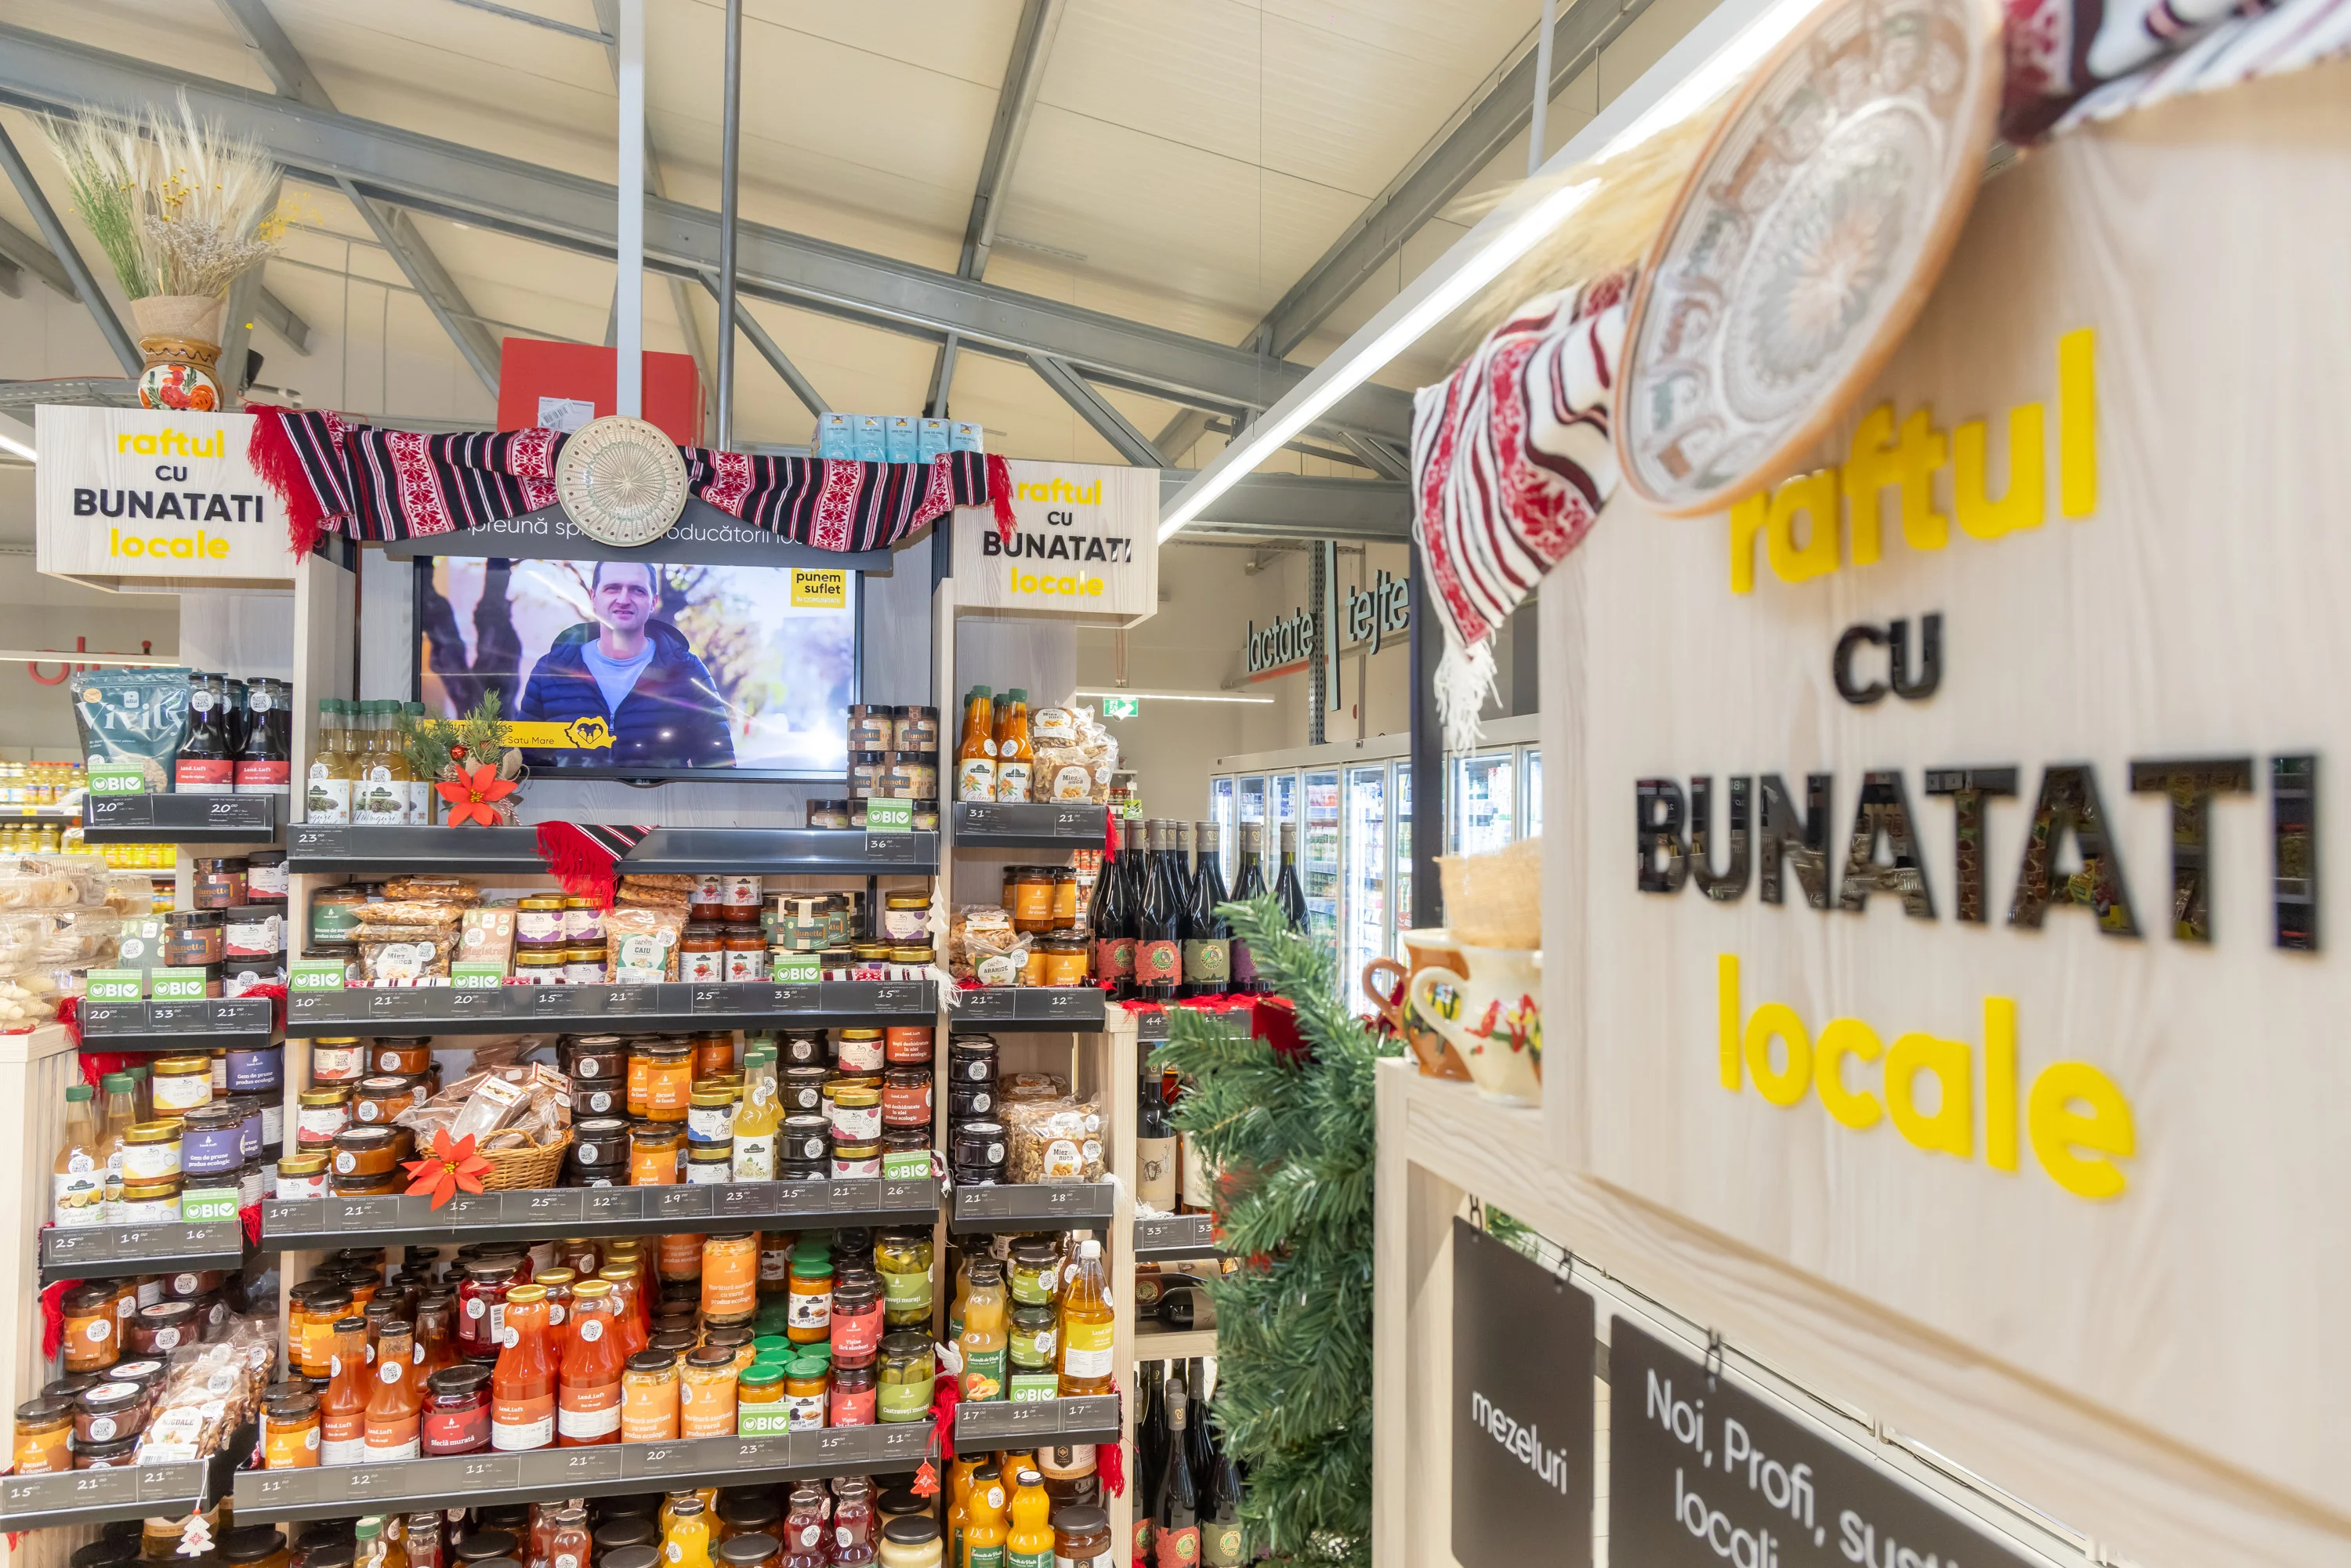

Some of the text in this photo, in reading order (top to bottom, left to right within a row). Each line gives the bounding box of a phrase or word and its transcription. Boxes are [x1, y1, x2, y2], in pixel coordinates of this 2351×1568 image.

[118, 429, 223, 458] raftul
[1727, 327, 2098, 596] raftul
[155, 465, 187, 482] CU
[1018, 480, 1102, 505] raftul
[74, 487, 263, 523] BUNATATI
[1048, 511, 1073, 527] CU
[110, 529, 230, 559] locale
[983, 531, 1131, 563] BUNATATI
[796, 573, 840, 583] punem
[1010, 567, 1103, 596] locale
[805, 583, 841, 594] suflet
[1346, 570, 1410, 655] tejte
[1248, 607, 1315, 672] lactate
[1833, 612, 1943, 705] CU
[78, 690, 188, 736] Vivity
[97, 803, 116, 812] 20
[212, 804, 230, 813] 20
[299, 834, 317, 842] 23
[1636, 750, 2322, 954] BUNATATI
[610, 993, 626, 1001] 21
[296, 998, 313, 1007] 10
[90, 1010, 110, 1019] 20
[155, 1009, 174, 1018] 33
[218, 1009, 236, 1017] 21
[1719, 951, 2137, 1198] locale
[887, 1186, 904, 1195] 26
[593, 1197, 610, 1206] 12
[665, 1194, 680, 1204] 19
[965, 1194, 981, 1203] 21
[270, 1208, 288, 1218] 19
[345, 1207, 364, 1216] 21
[121, 1233, 139, 1243] 19
[187, 1230, 205, 1240] 16
[56, 1238, 76, 1248] 25
[731, 1295, 751, 1304] ecologic
[883, 1403, 929, 1415] Castraveți murați
[646, 1413, 671, 1421] asortată
[710, 1410, 733, 1421] asortată
[1013, 1410, 1028, 1419] 11
[643, 1430, 667, 1439] ecologic
[705, 1427, 730, 1437] ecologic
[450, 1435, 475, 1445] murată
[822, 1439, 838, 1447] 15
[887, 1435, 904, 1443] 11
[1473, 1389, 1567, 1494] mezeluri
[740, 1446, 757, 1454] 23
[647, 1451, 665, 1461] 20
[1647, 1367, 1712, 1468] Noi,
[1725, 1417, 1825, 1548] Profi,
[570, 1457, 588, 1466] 21
[466, 1465, 484, 1474] 11
[145, 1472, 165, 1483] 21
[351, 1476, 371, 1485] 12
[78, 1479, 98, 1490] 21
[263, 1482, 281, 1491] 11
[11, 1487, 32, 1497] 15
